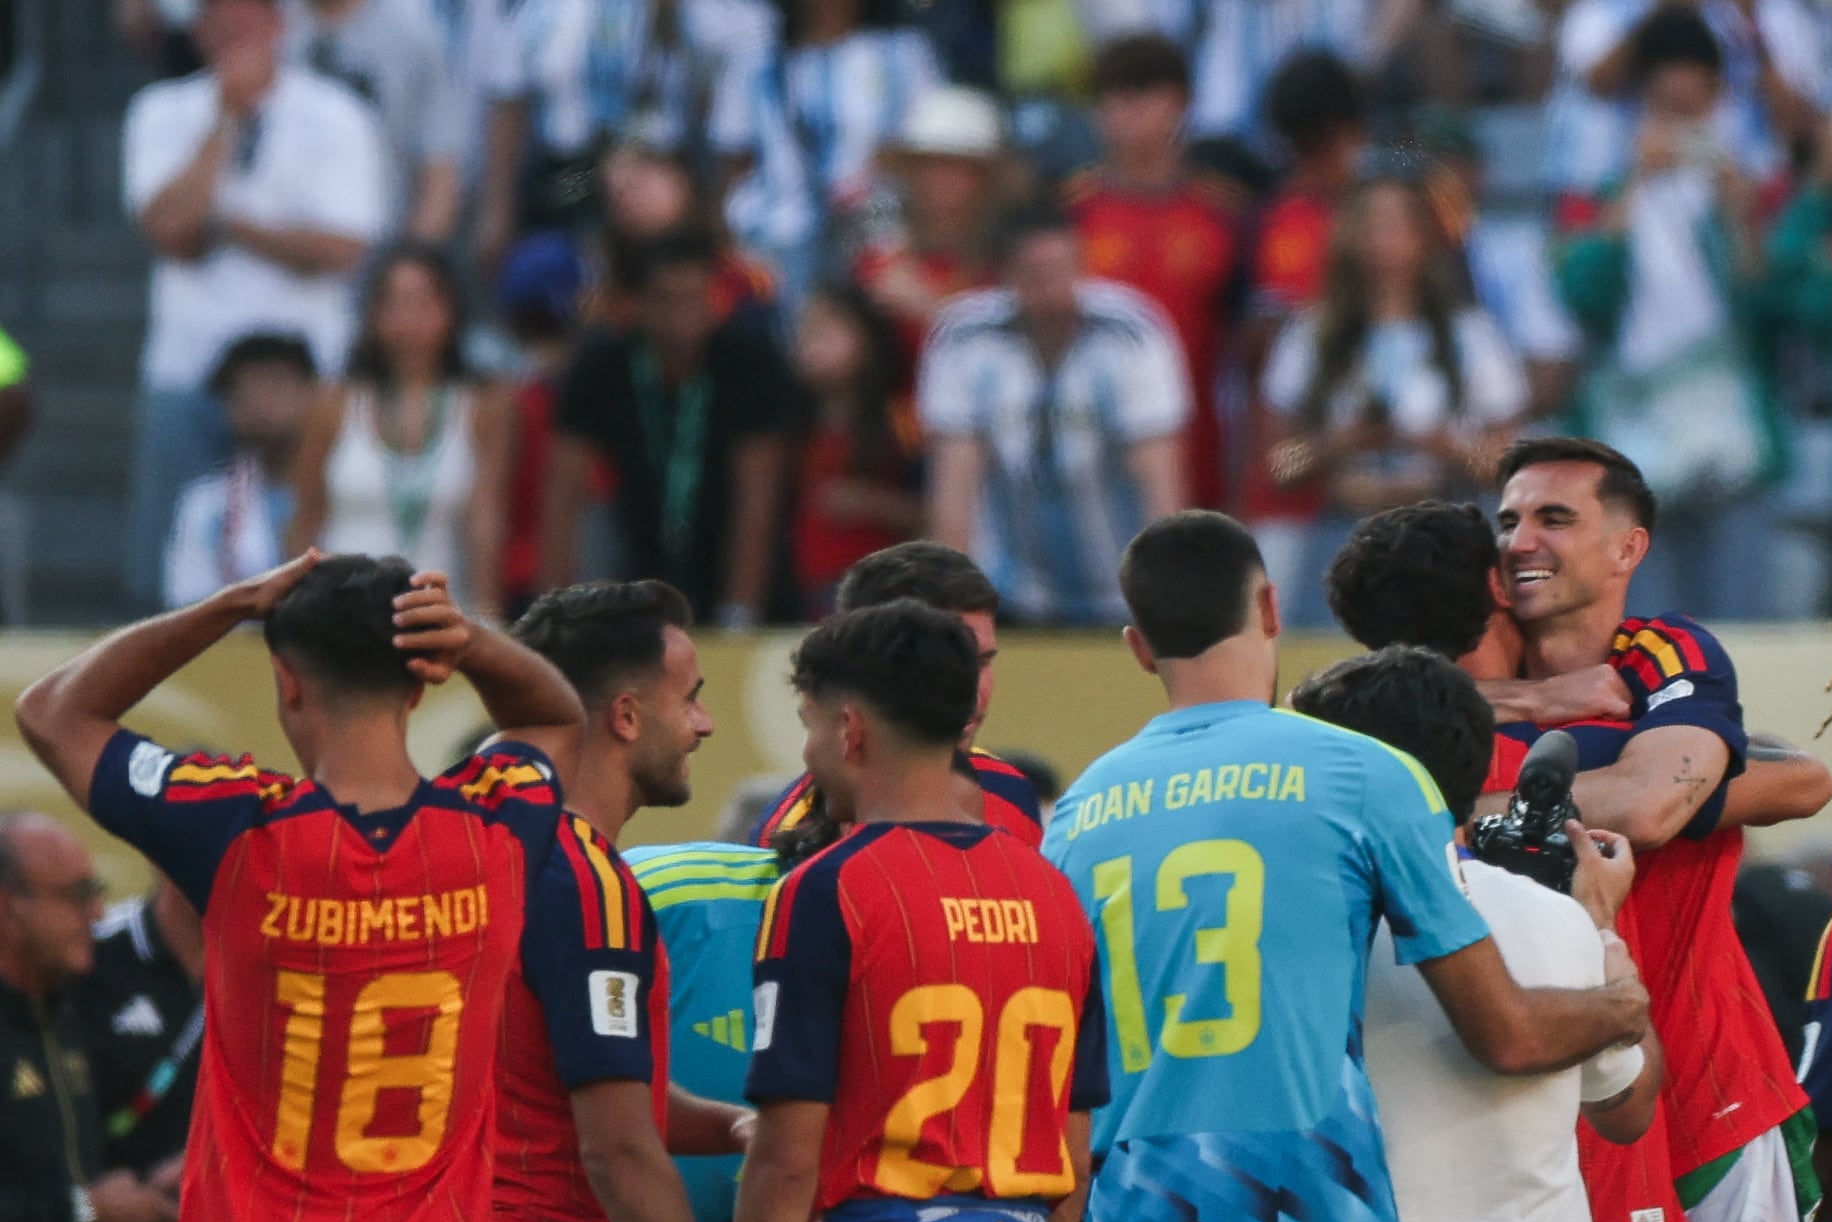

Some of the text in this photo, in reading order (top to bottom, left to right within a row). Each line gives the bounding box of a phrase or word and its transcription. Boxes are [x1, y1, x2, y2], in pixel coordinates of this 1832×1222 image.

[1067, 763, 1306, 841] JOAN GARCIA
[260, 884, 489, 945] ZUBIMENDI
[941, 897, 1040, 944] PEDRI
[1093, 838, 1265, 1074] 13
[272, 970, 463, 1174] 18
[874, 983, 1079, 1199] 20
